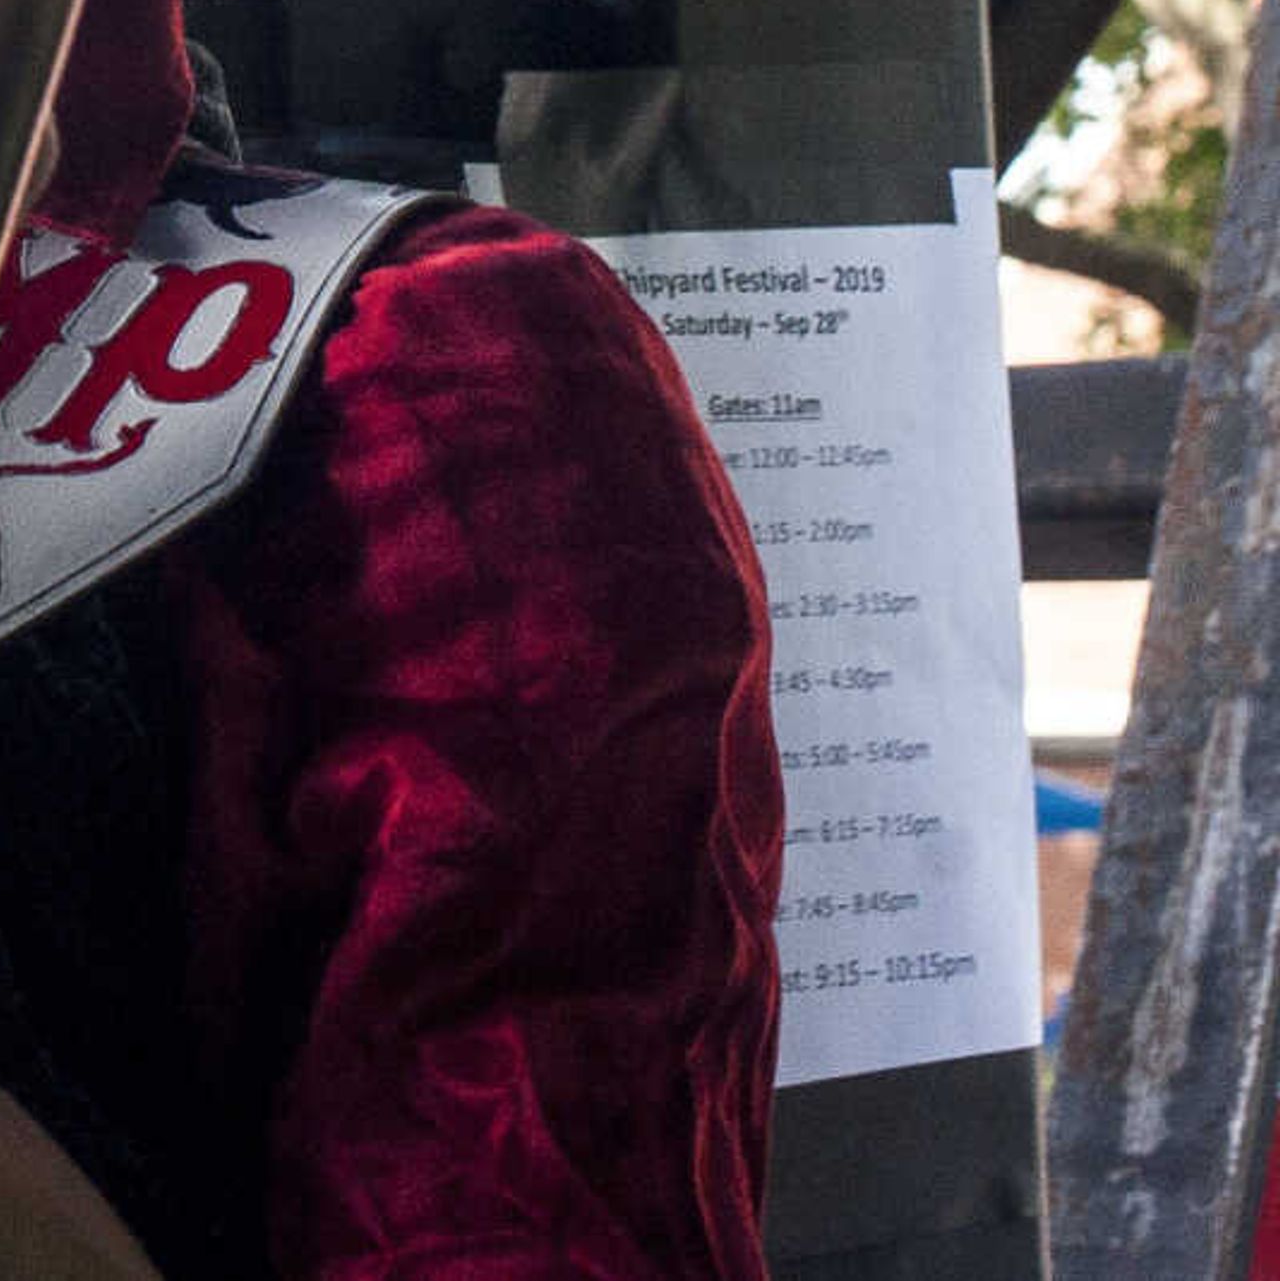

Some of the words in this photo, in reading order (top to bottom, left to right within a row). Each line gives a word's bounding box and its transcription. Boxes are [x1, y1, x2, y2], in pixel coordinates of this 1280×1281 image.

[623, 267, 716, 299] hipyard
[723, 267, 808, 293] Festival
[833, 265, 885, 293] 2019
[662, 310, 751, 340] Saturday
[775, 308, 809, 338] Sep
[815, 960, 860, 990] 9:15
[884, 951, 974, 984] 10:15pm
